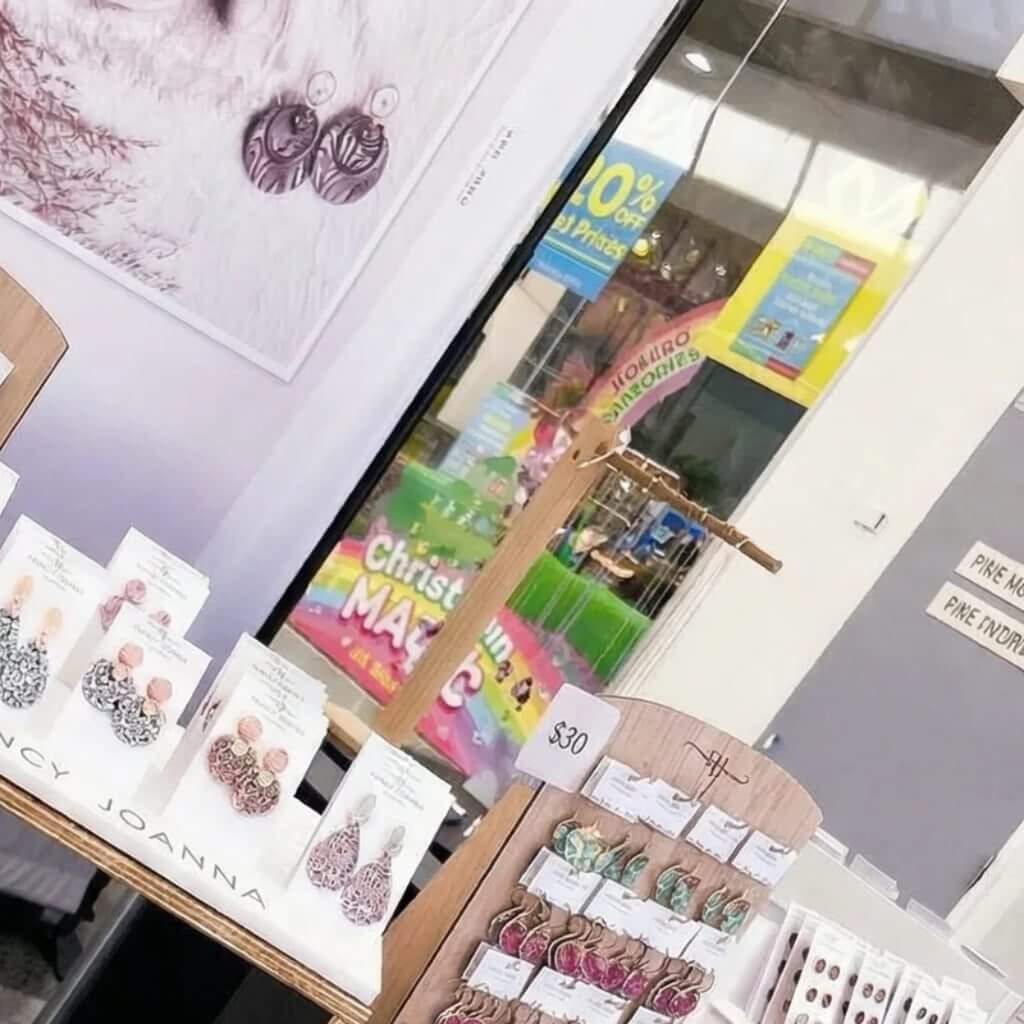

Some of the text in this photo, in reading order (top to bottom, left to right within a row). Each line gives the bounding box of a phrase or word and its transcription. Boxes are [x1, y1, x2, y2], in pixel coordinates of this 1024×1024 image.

[364, 533, 465, 611] Christ
[548, 720, 589, 756] $30
[97, 798, 267, 910] JOANNA
